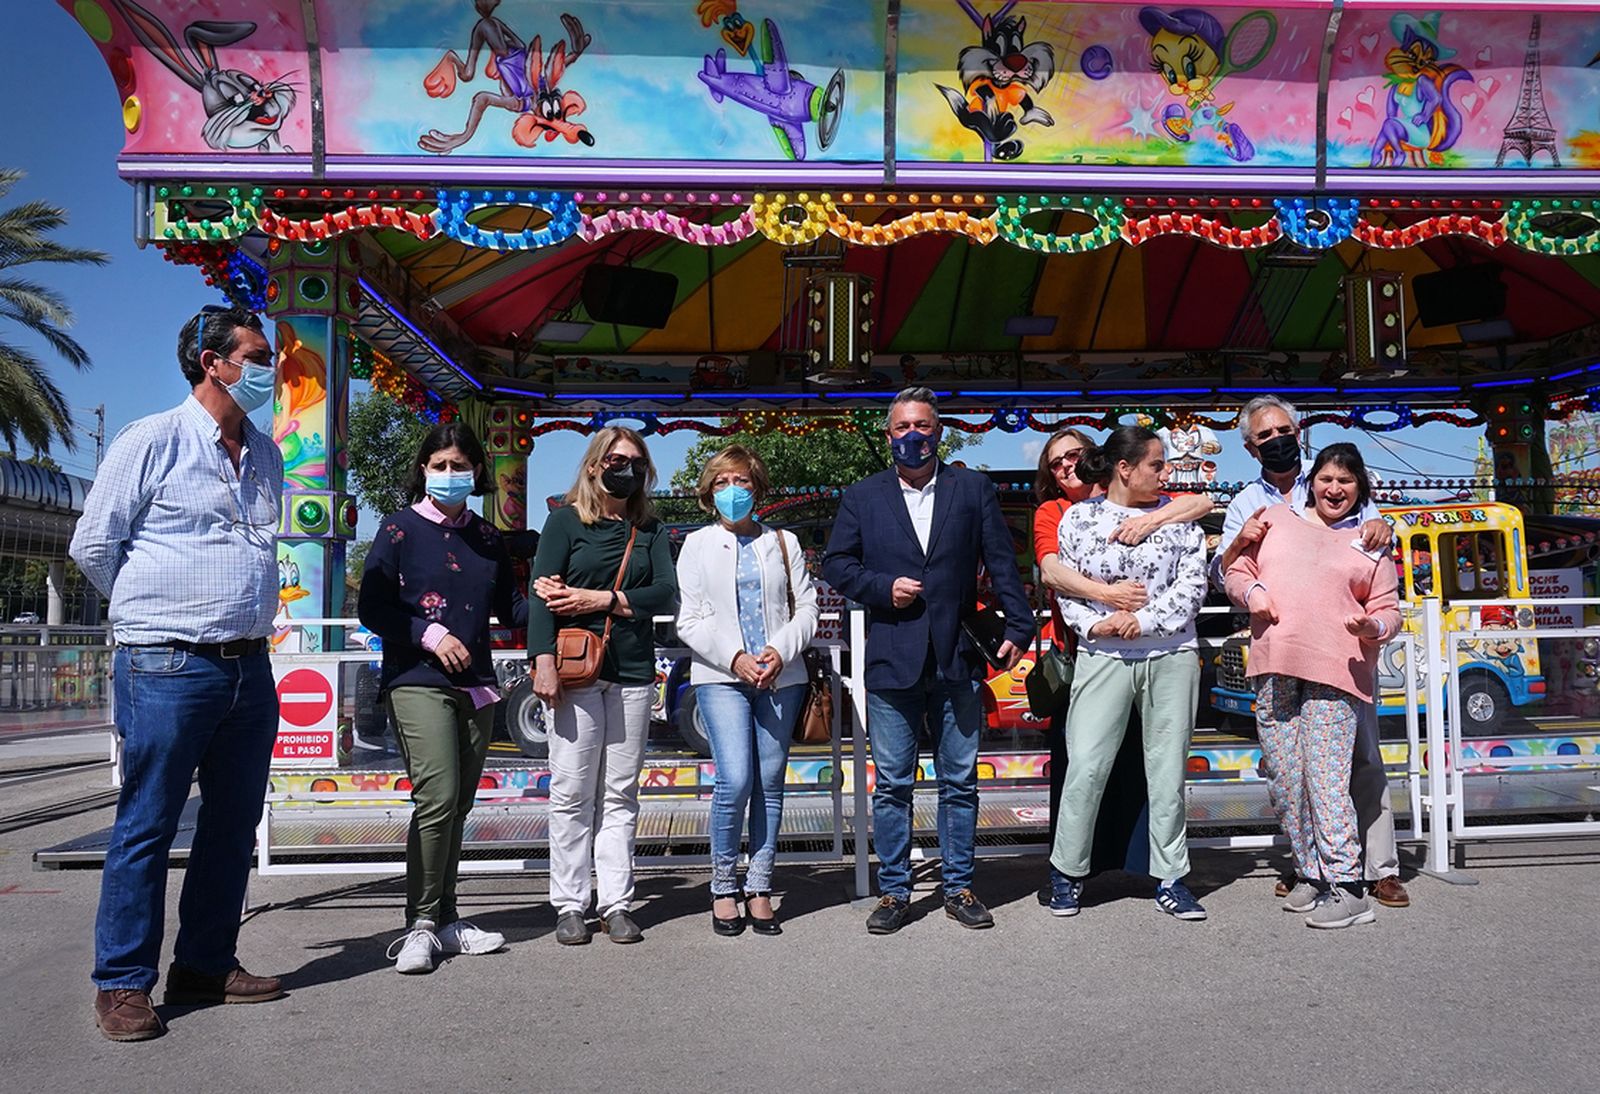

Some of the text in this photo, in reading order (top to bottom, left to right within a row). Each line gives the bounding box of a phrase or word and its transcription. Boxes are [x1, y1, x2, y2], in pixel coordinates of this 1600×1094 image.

[1401, 509, 1487, 527] WARNER
[1528, 575, 1560, 584] OCHE
[277, 735, 329, 744] PROHIBIDO
[283, 746, 322, 755] EL PASO
